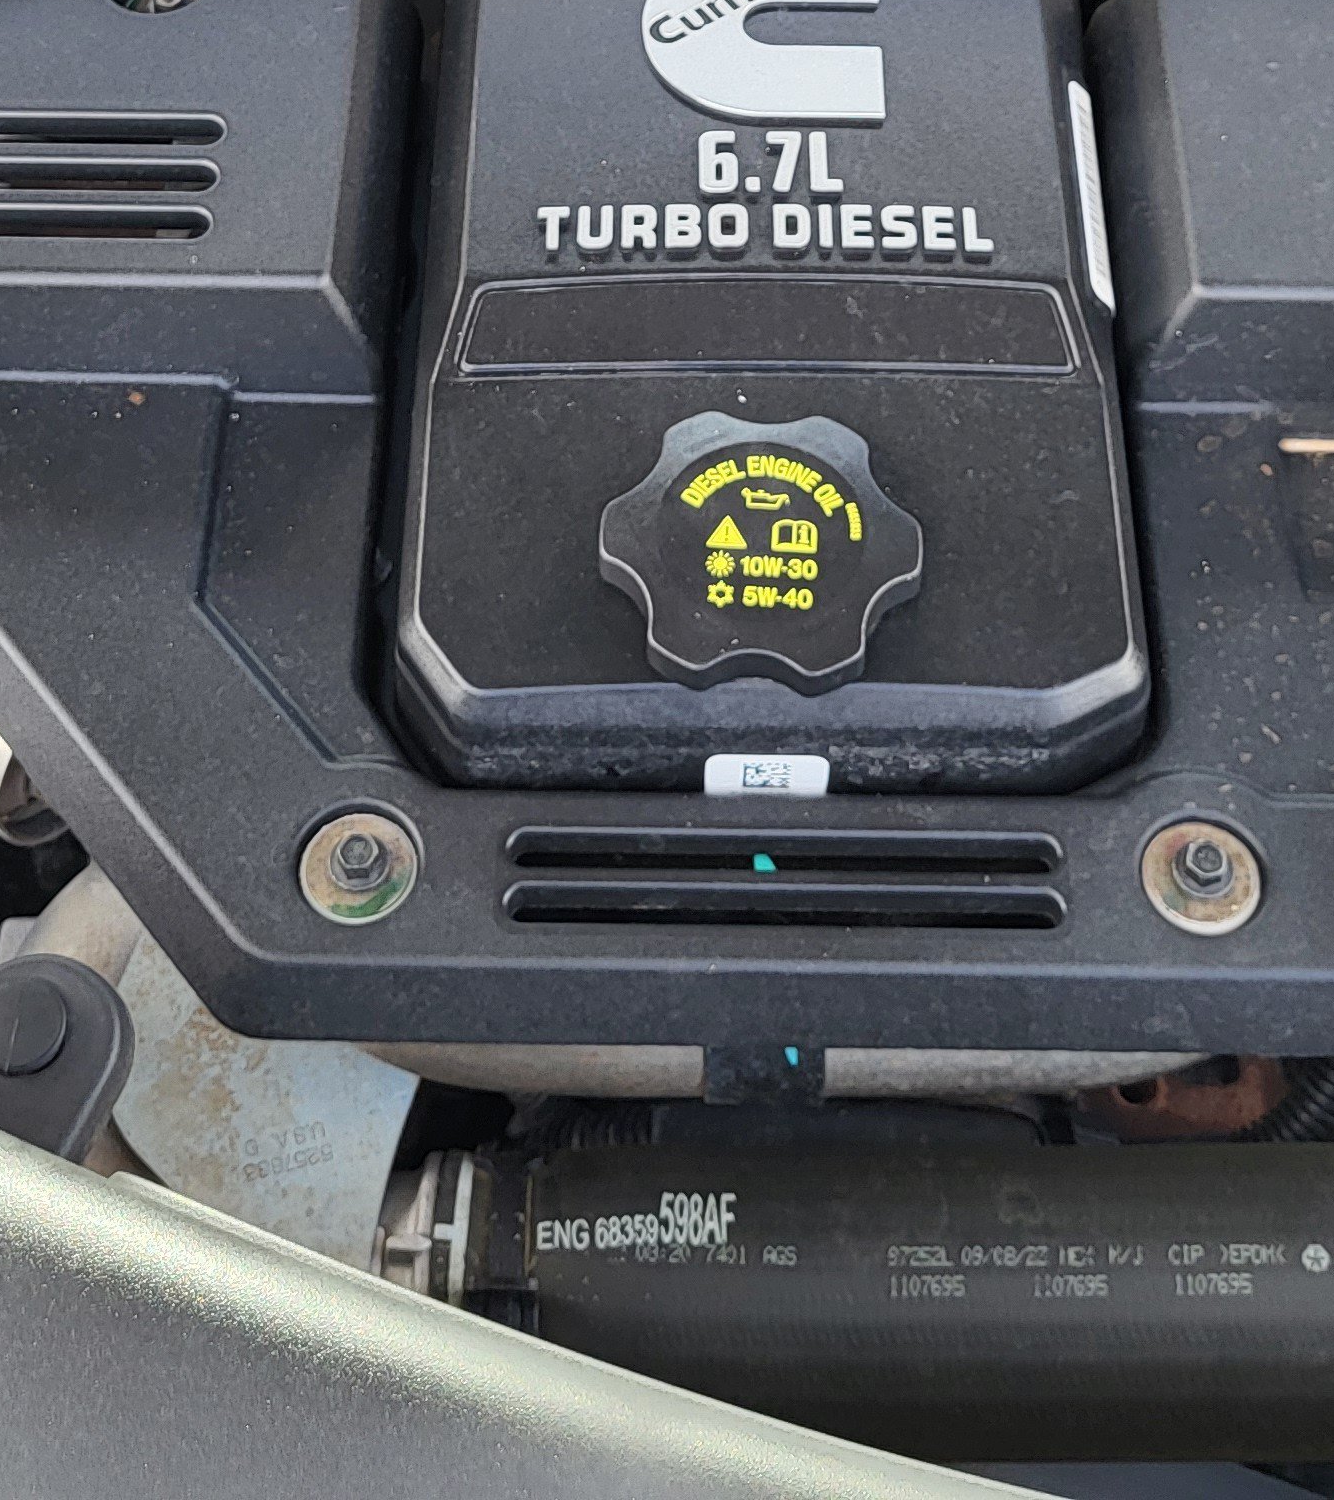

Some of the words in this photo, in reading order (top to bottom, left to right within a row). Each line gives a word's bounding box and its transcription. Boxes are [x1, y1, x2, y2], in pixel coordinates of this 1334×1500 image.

[698, 130, 845, 194] 6.7L
[536, 203, 750, 252] TURBO
[772, 203, 995, 254] DIESEL
[679, 458, 747, 509] DIESEL
[745, 454, 823, 494] ENGINE
[812, 482, 845, 518] OIL
[739, 554, 819, 581] 10W-30
[741, 584, 814, 611] 5W-40
[535, 1218, 592, 1251] ENG
[762, 1244, 799, 1266] AGS
